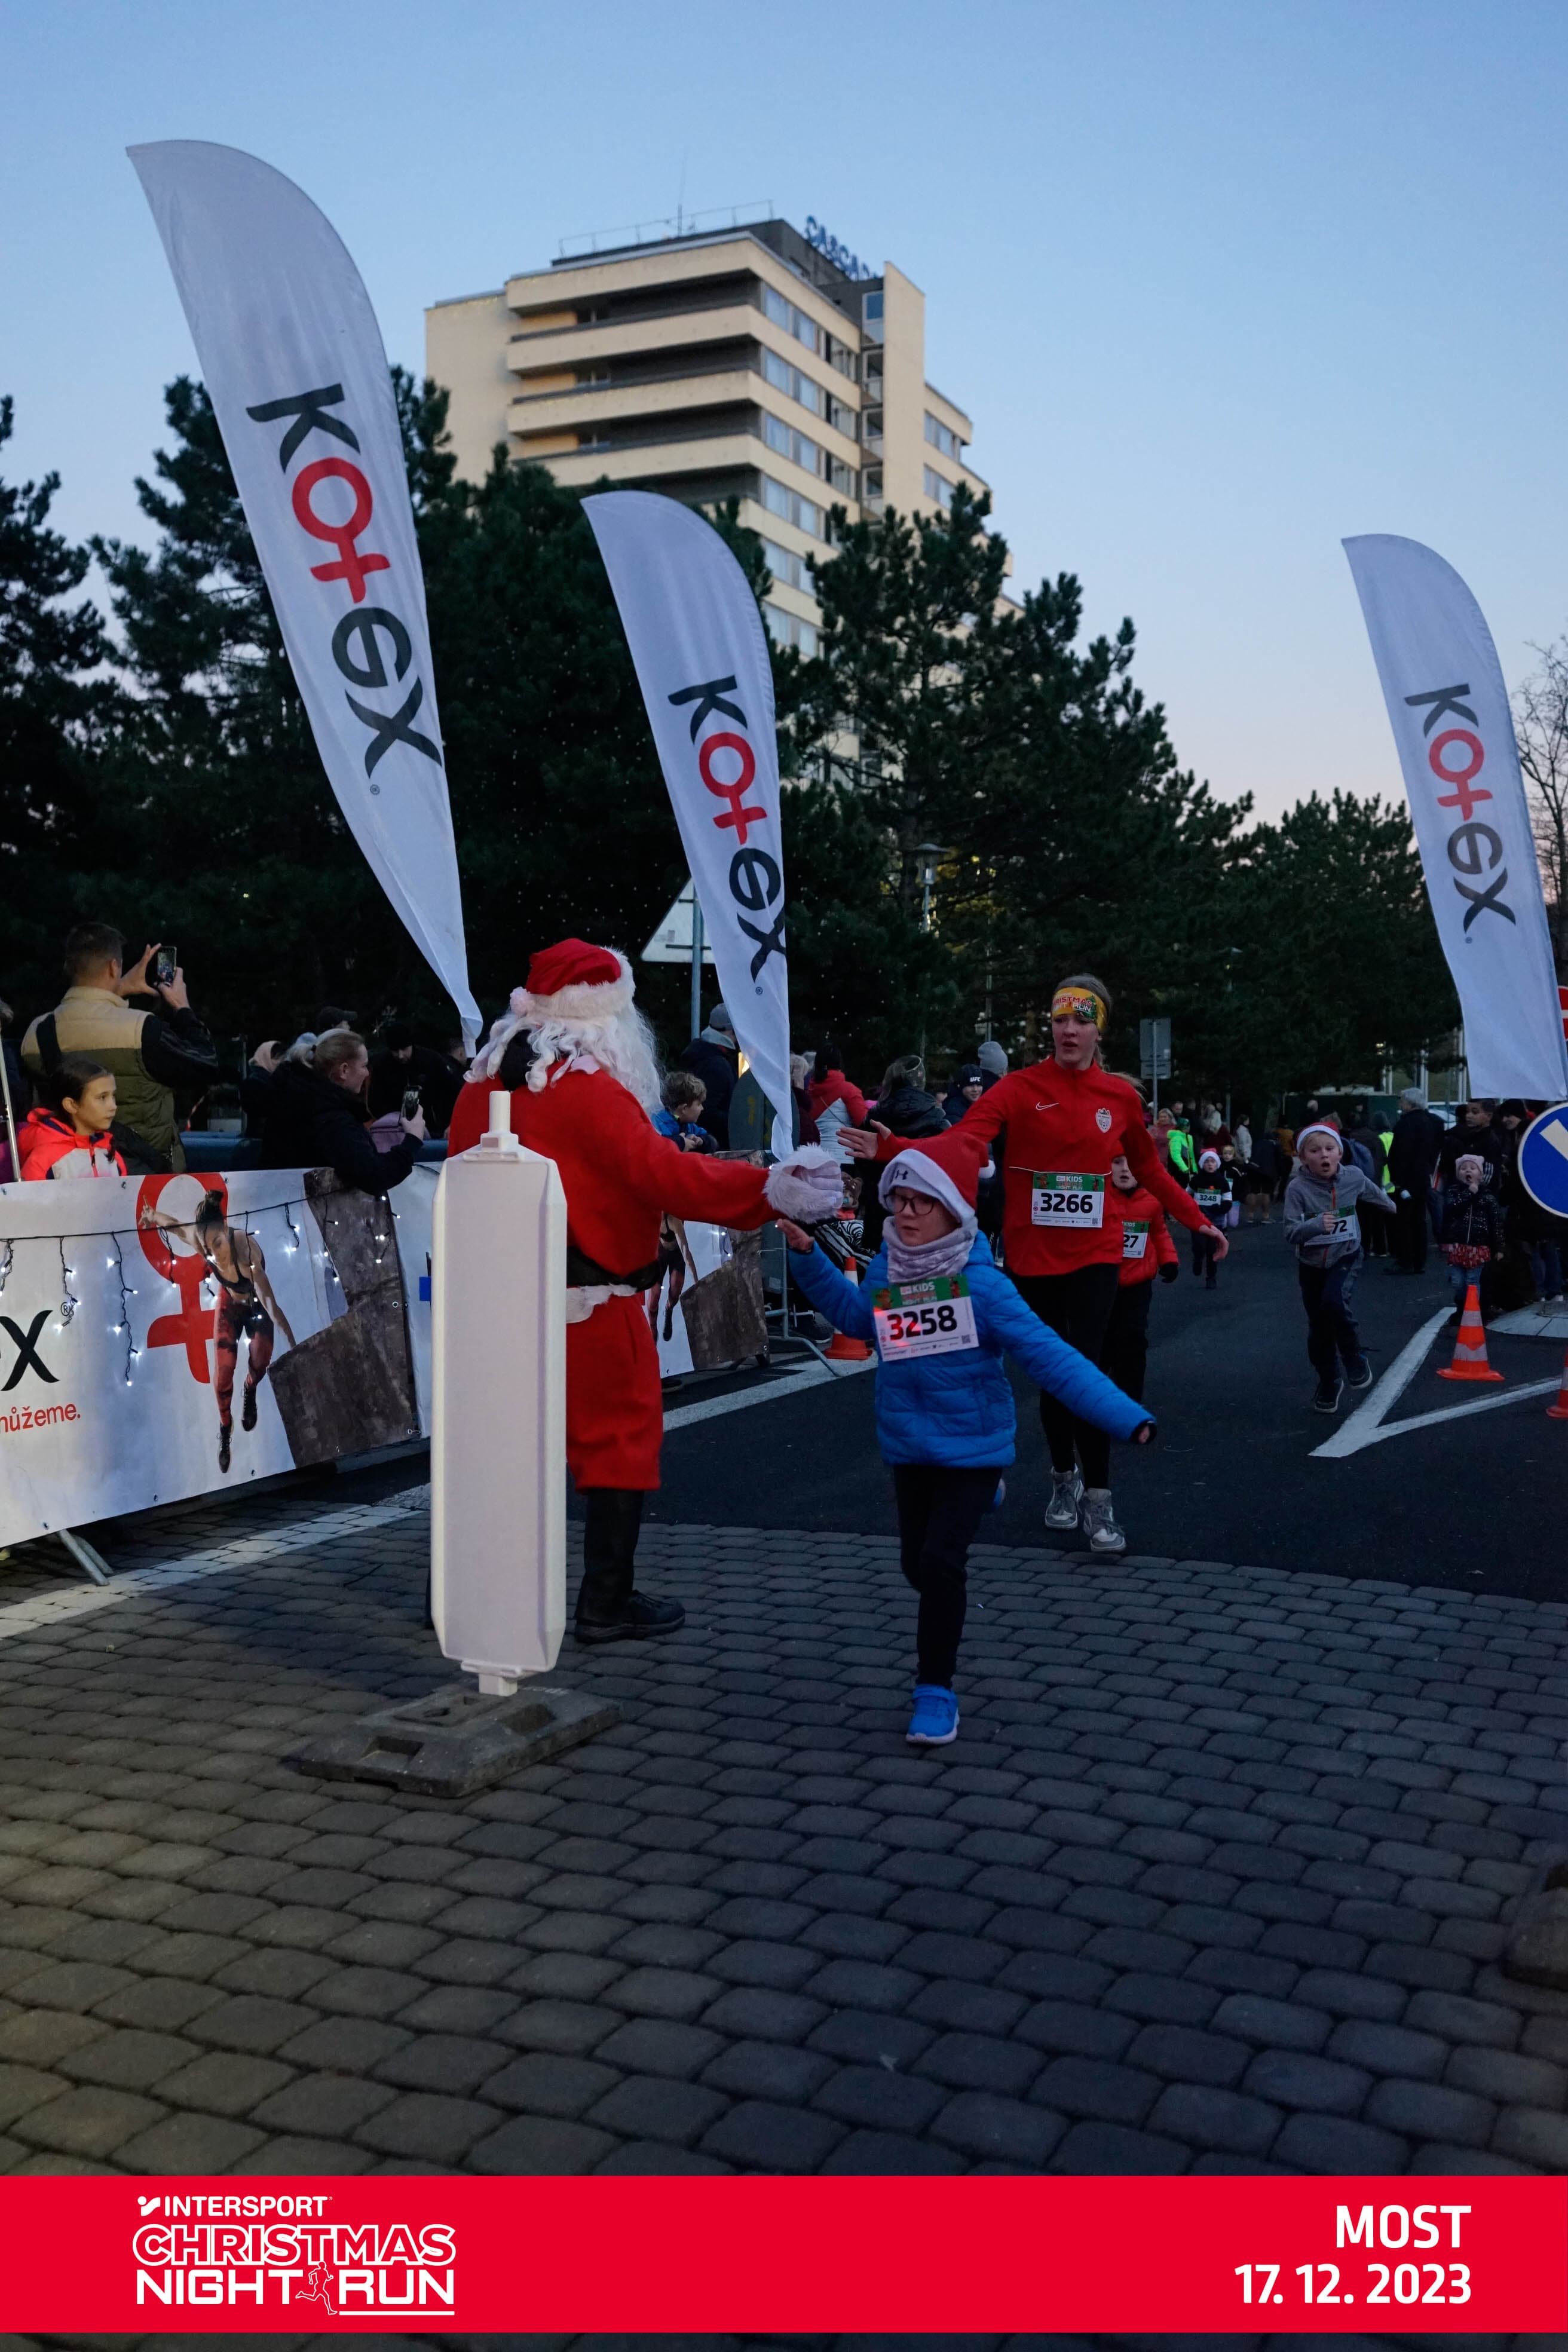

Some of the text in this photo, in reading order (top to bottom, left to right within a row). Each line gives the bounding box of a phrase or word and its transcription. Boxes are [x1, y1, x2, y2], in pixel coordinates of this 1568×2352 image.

[1040, 1193, 1093, 1214] 3266
[1331, 1220, 1348, 1235] 72
[1123, 1234, 1139, 1248] 27
[912, 1281, 936, 1293] KIDS
[887, 1305, 958, 1341] 3258
